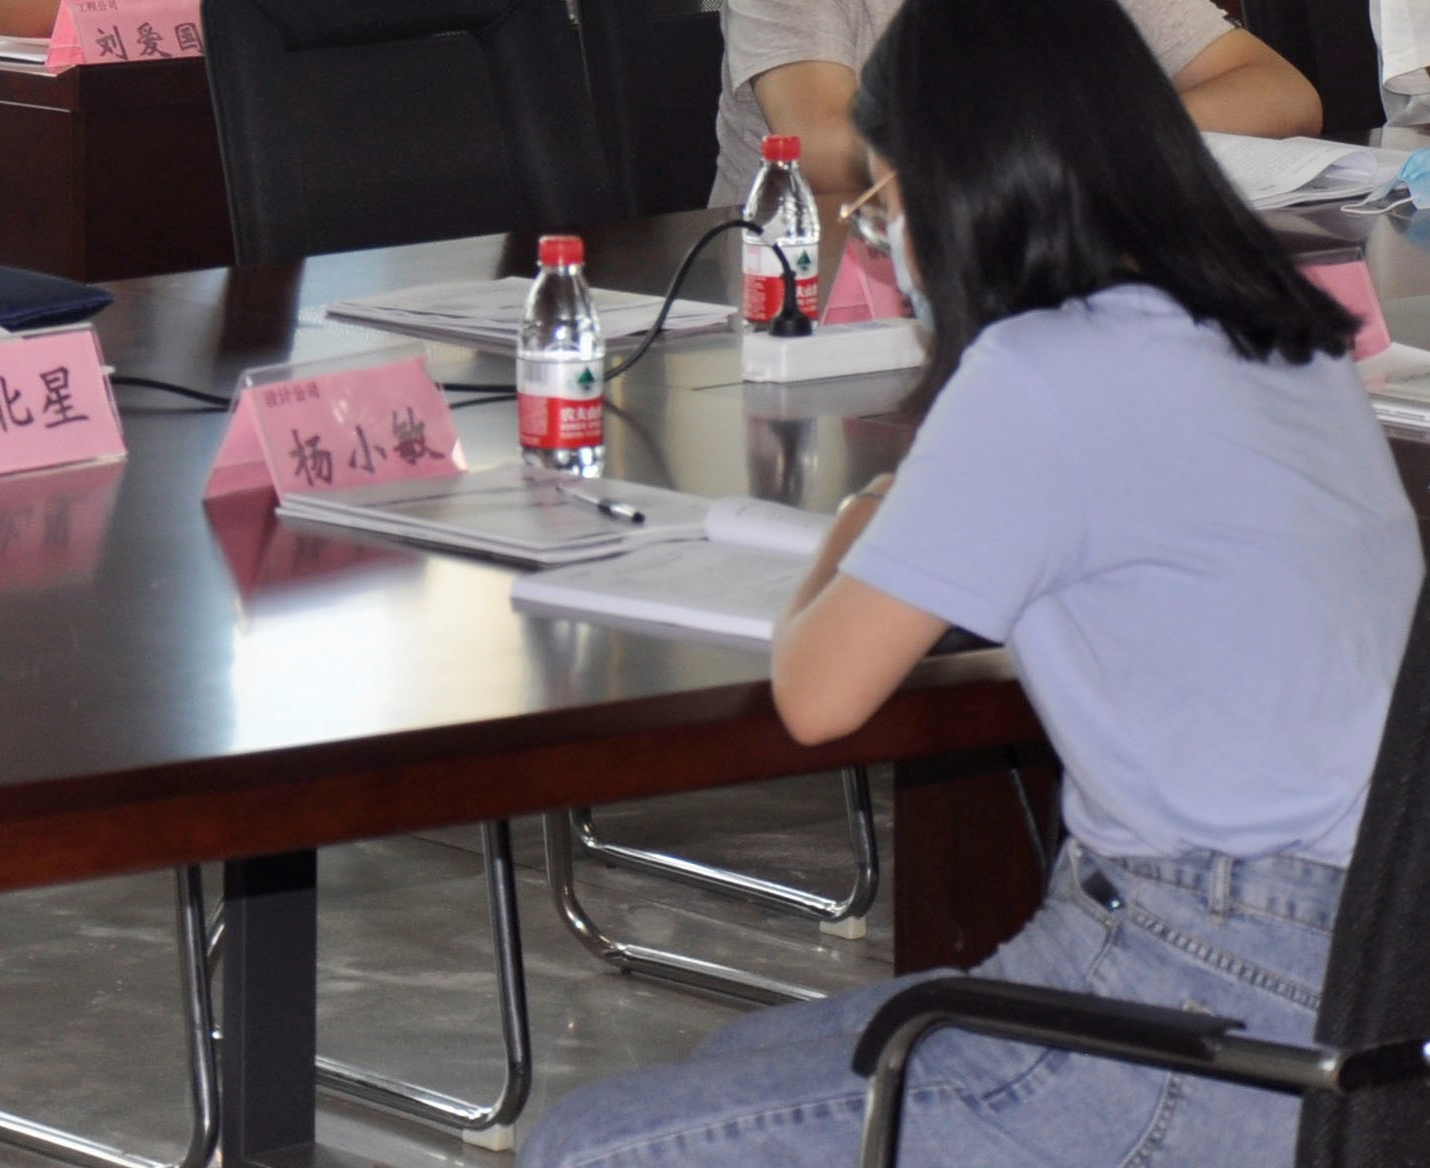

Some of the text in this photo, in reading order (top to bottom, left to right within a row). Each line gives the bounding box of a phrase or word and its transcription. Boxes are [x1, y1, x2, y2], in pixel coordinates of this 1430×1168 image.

[96, 22, 203, 60] 刘爱国
[289, 406, 446, 487] 杨小敏
